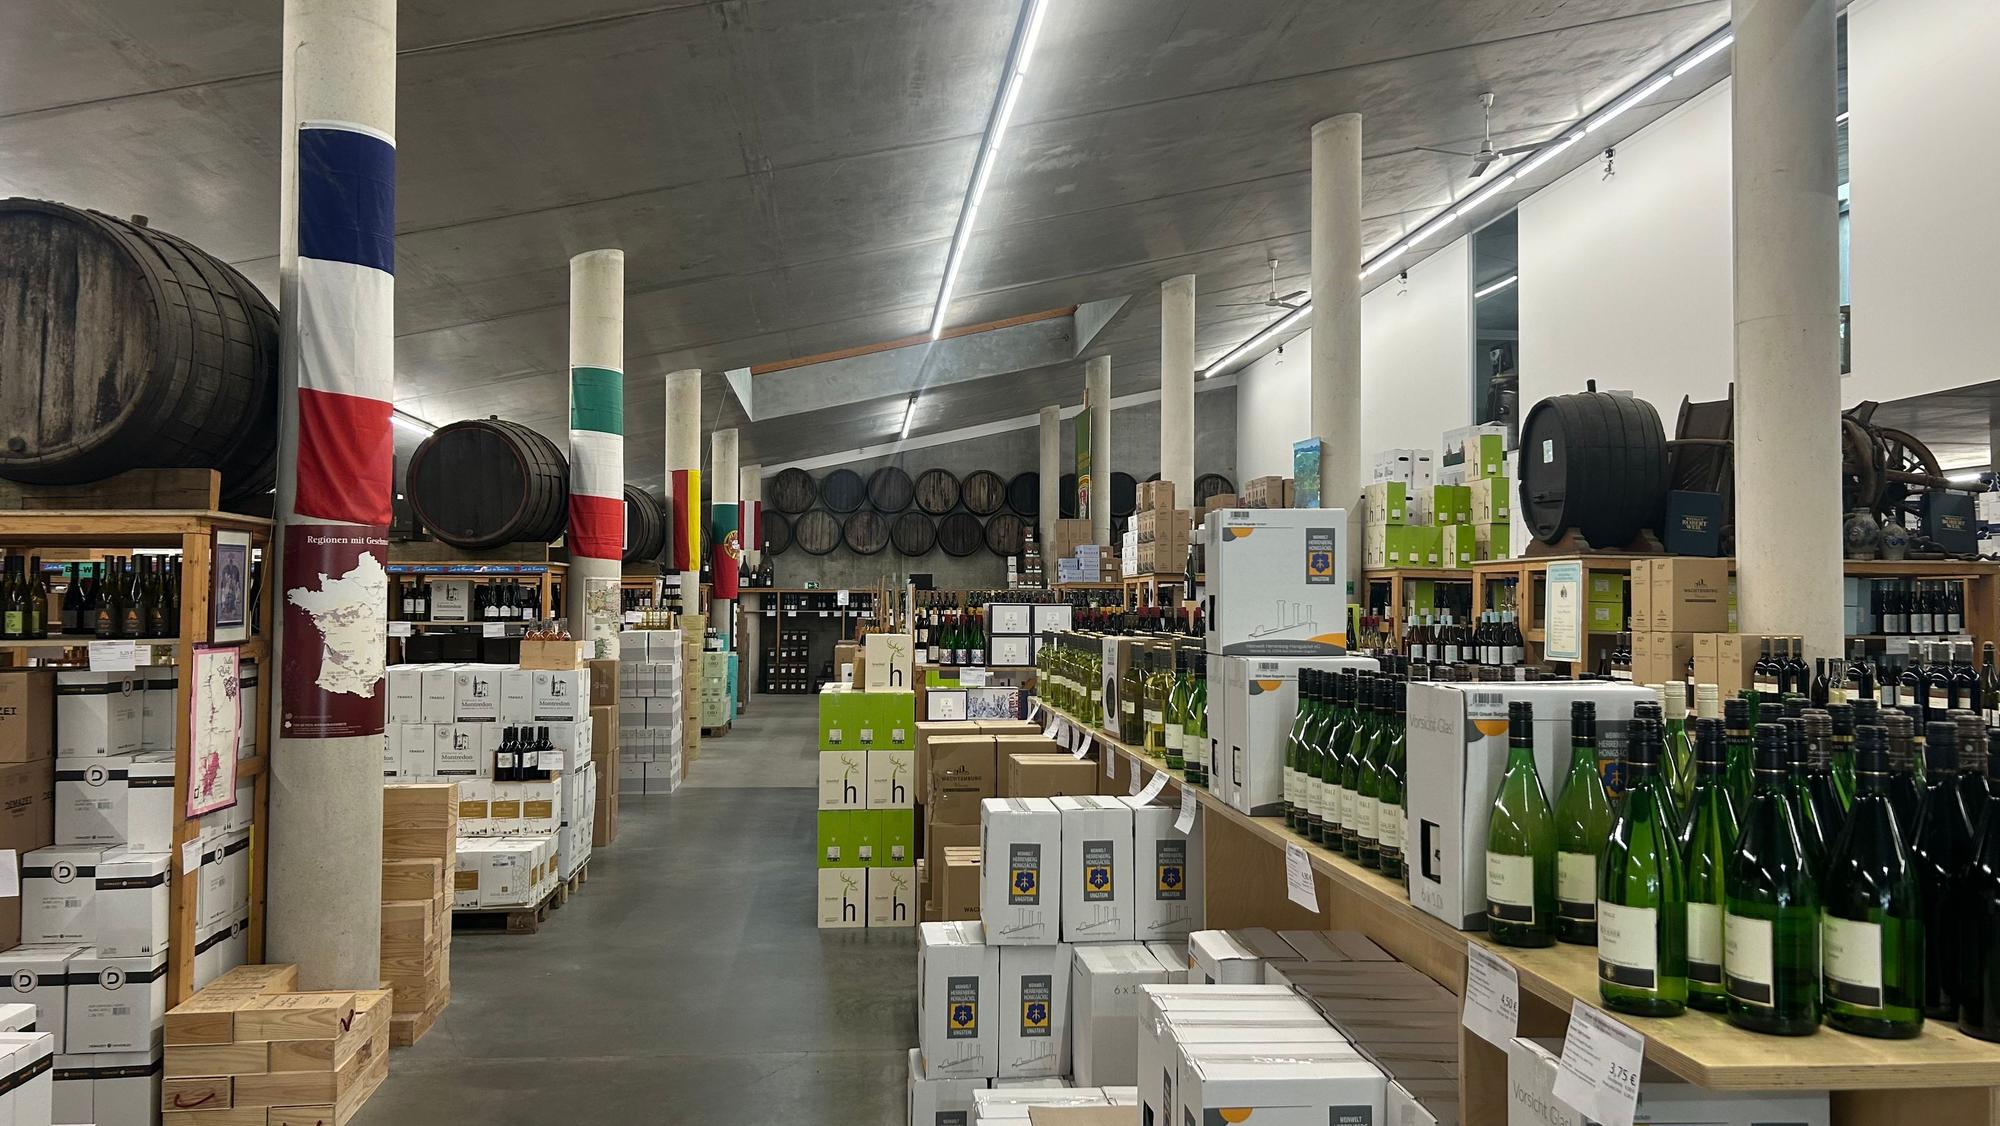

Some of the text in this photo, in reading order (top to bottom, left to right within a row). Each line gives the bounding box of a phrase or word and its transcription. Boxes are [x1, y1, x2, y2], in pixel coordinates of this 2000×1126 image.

[307, 536, 348, 545] Regionen
[889, 663, 902, 687] h
[1410, 714, 1436, 732] Vorsicht
[92, 770, 102, 781] D
[844, 779, 856, 804] h
[892, 779, 905, 803] h
[59, 867, 71, 878] D
[843, 897, 855, 921] h
[893, 896, 905, 921] h
[20, 975, 31, 987] D
[107, 972, 119, 984] D
[1501, 994, 1517, 1012] 4,50 €
[1609, 1062, 1637, 1086] 3,75 €
[1513, 1080, 1548, 1119] Vorsicht
